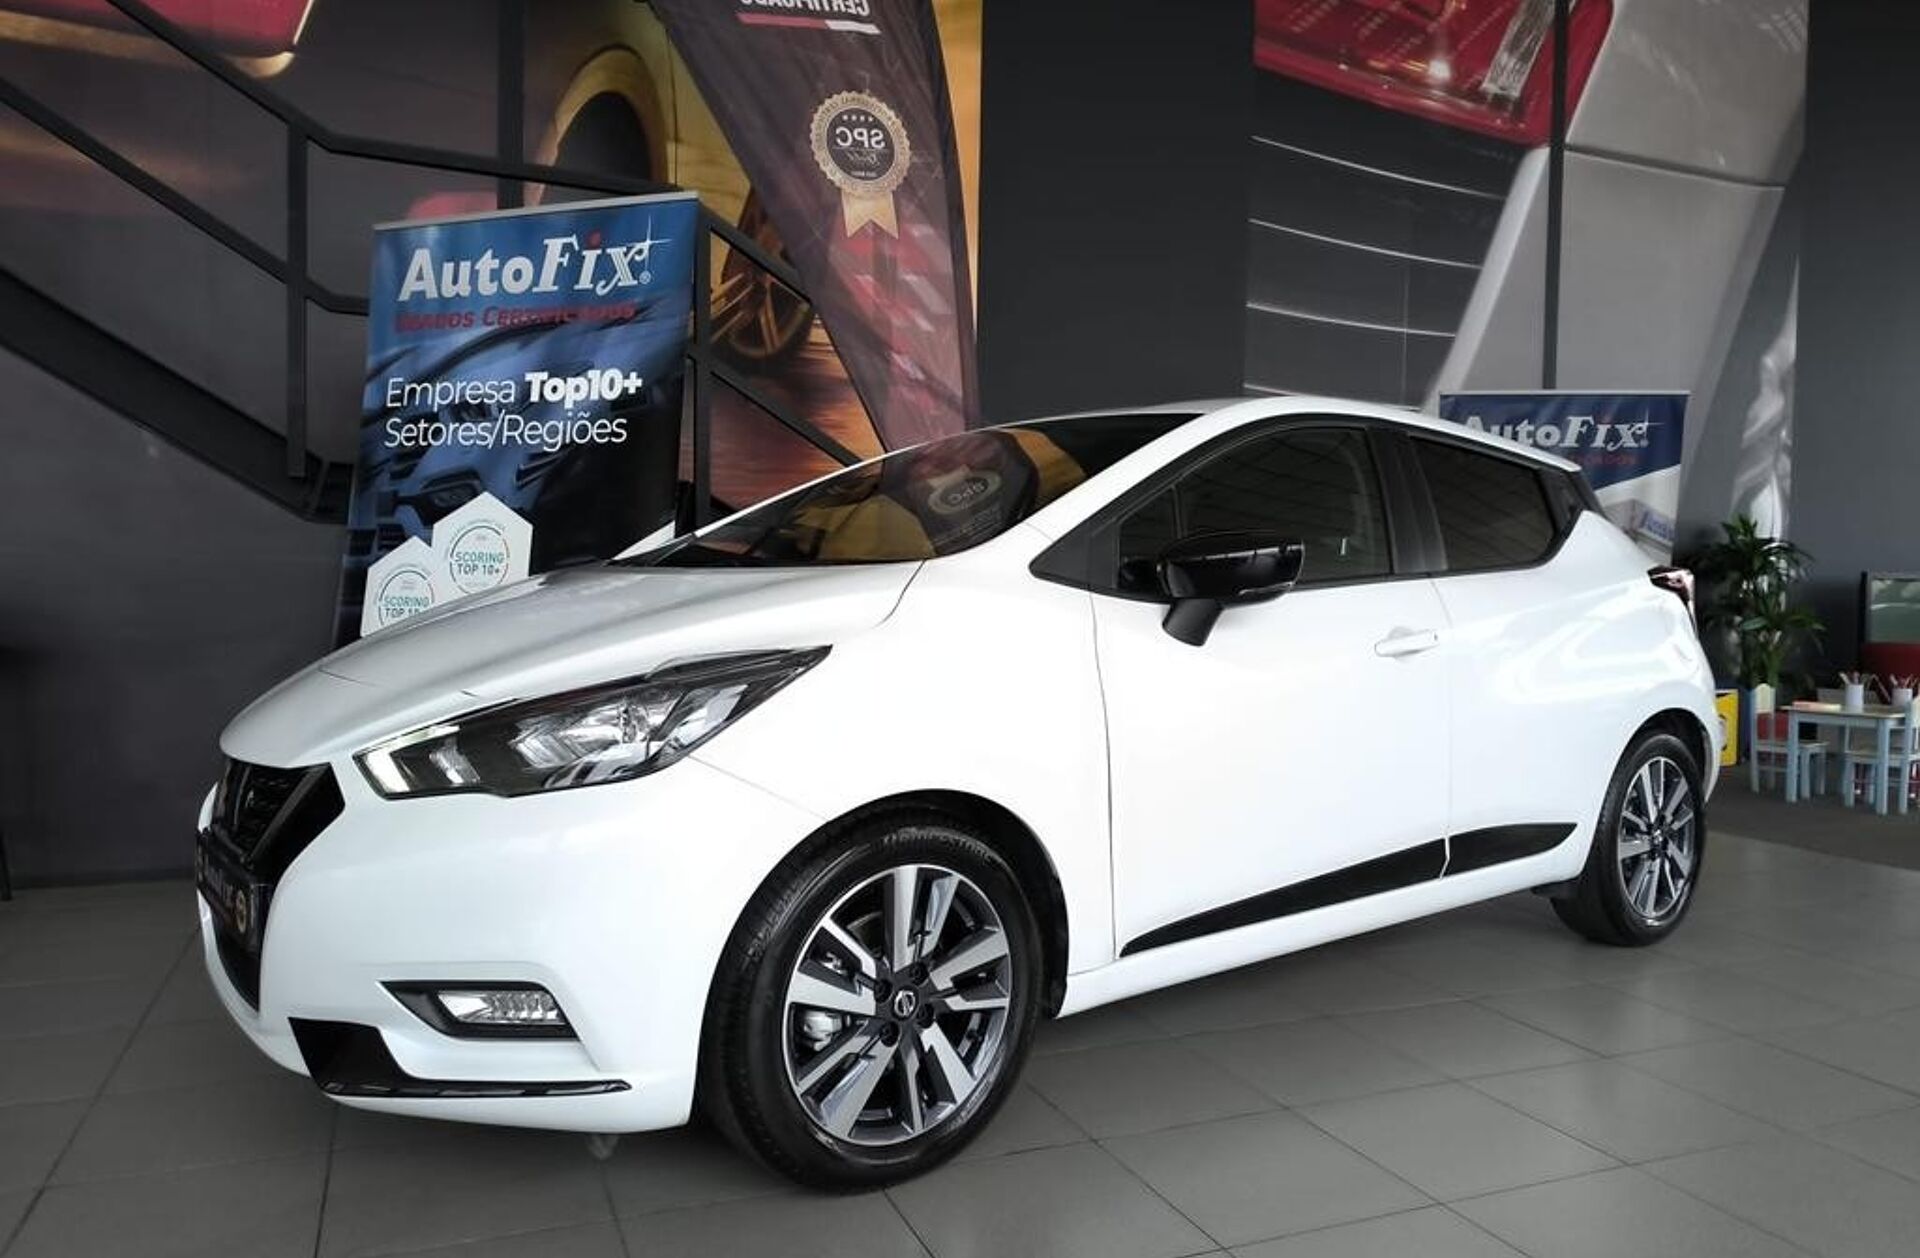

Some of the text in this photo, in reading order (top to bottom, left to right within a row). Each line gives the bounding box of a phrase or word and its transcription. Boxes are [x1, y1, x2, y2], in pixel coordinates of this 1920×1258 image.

[397, 232, 649, 302] AutoFix
[386, 368, 643, 412] Empresa Top10+
[384, 410, 628, 452] Setores/Regiões
[455, 551, 505, 563] SCORING
[457, 563, 479, 575] TOP
[384, 596, 431, 608] SCORING
[385, 608, 406, 618] TOP
